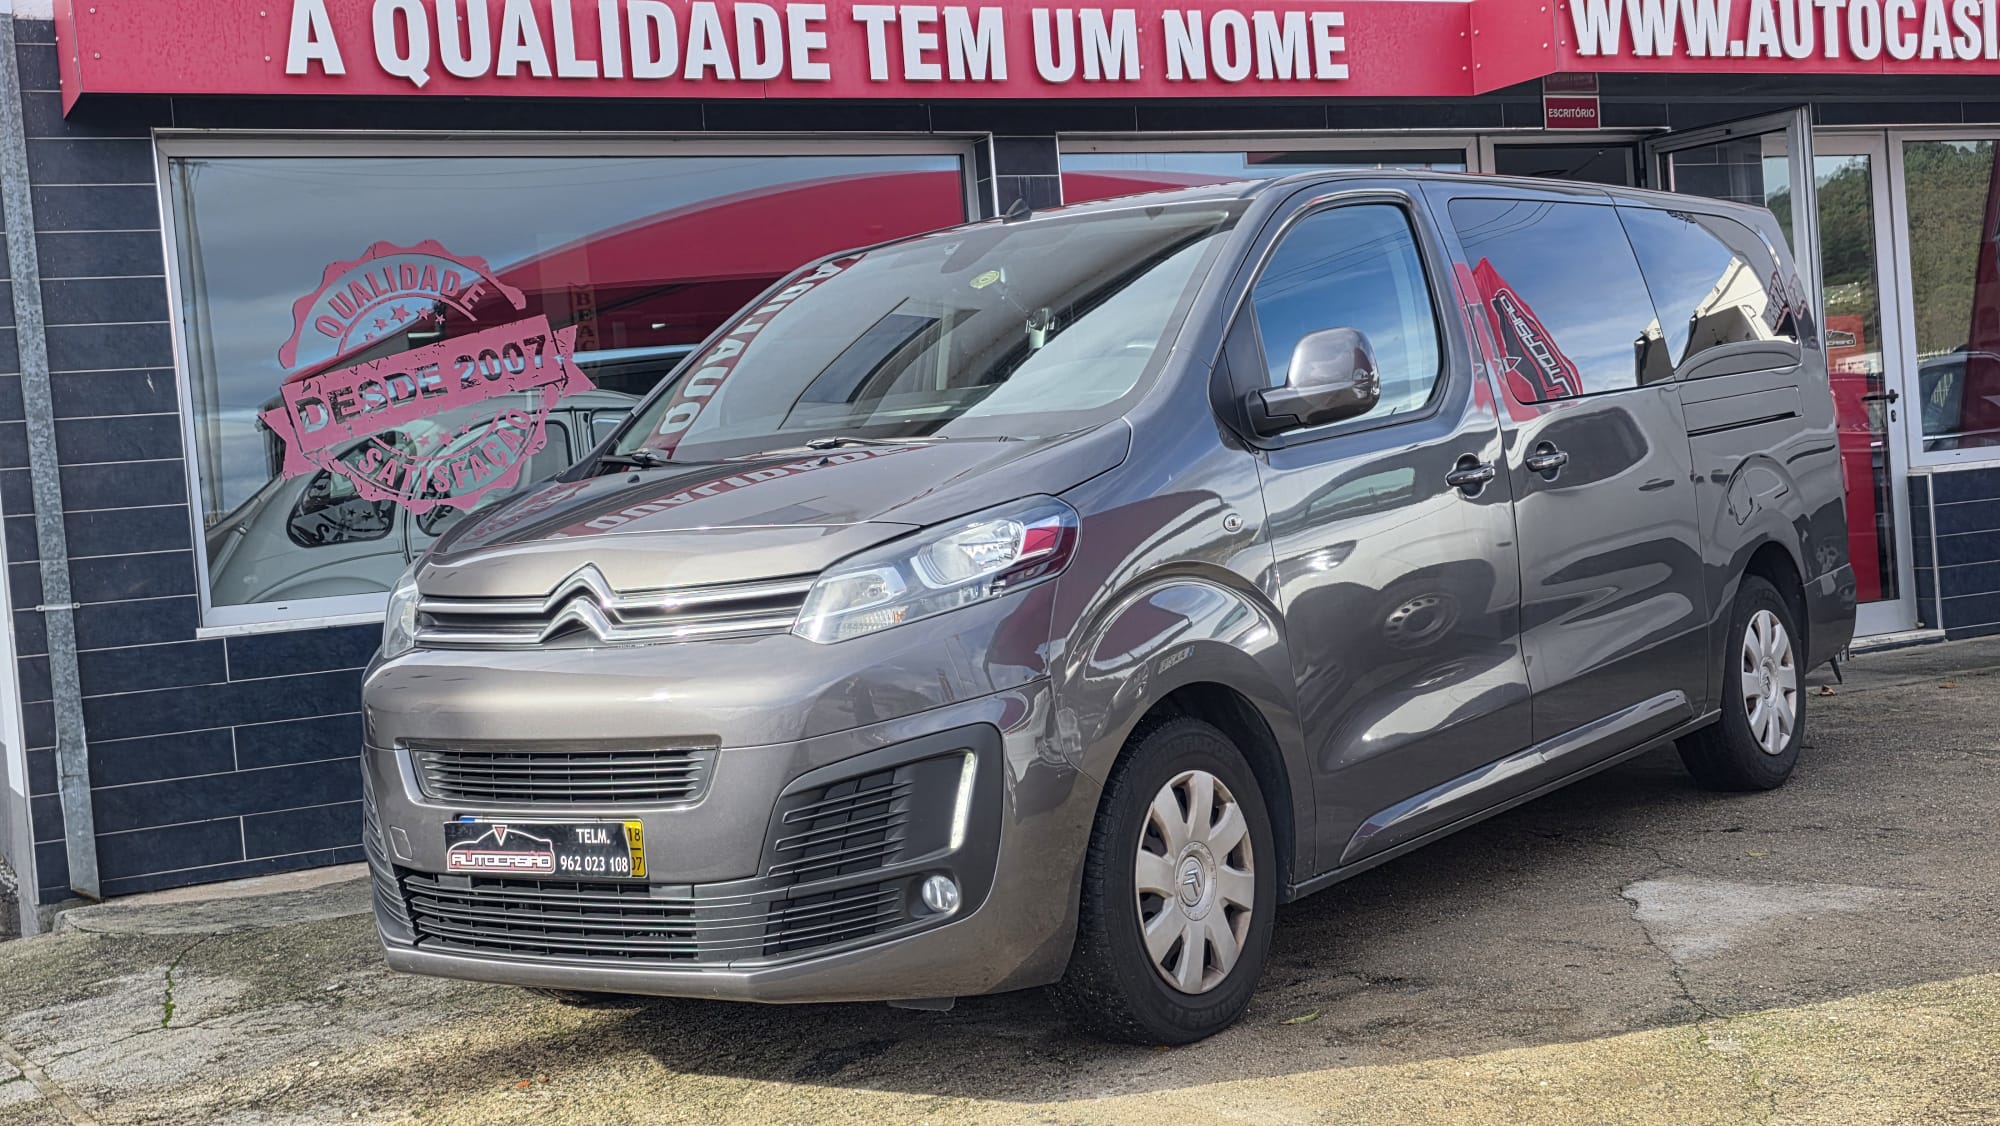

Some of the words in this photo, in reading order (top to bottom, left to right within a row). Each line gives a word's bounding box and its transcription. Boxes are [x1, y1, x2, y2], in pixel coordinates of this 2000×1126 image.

[285, 0, 346, 75] A
[372, 0, 831, 88] QUALIDADE
[852, 4, 1008, 81] TEM
[1031, 7, 1141, 83] UM
[1161, 9, 1350, 82] NOME
[1548, 106, 1596, 118] ESCRITÓRIO
[315, 262, 487, 340] QUALIDADE
[294, 361, 449, 434] DESDE
[453, 333, 547, 390] 2007
[575, 828, 611, 845] TELM.
[628, 827, 641, 842] 18
[560, 855, 582, 871] 962
[584, 856, 606, 872] 023
[609, 856, 629, 873] 108
